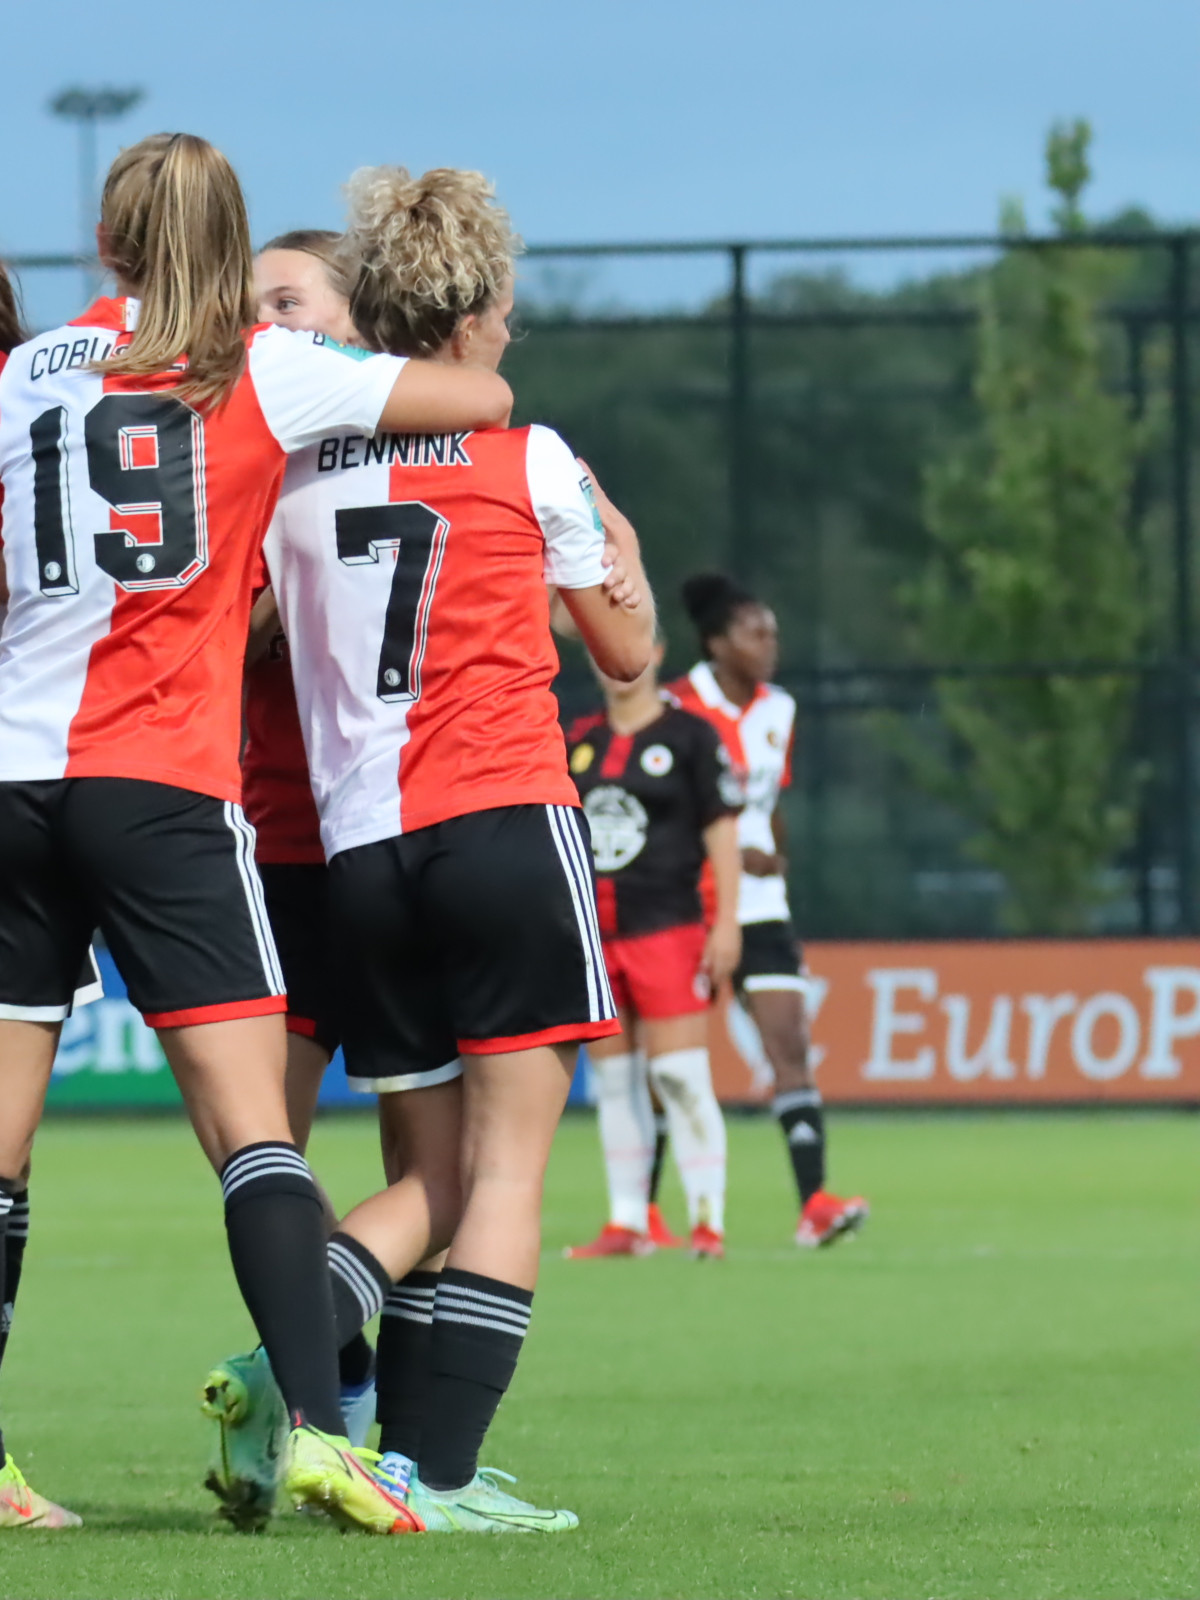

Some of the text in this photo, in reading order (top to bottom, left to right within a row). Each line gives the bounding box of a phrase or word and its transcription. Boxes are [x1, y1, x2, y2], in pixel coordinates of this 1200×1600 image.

[30, 390, 209, 597] 19
[317, 430, 474, 473] BENNINK
[335, 501, 450, 704] 7
[860, 964, 1200, 1081] EuroP
